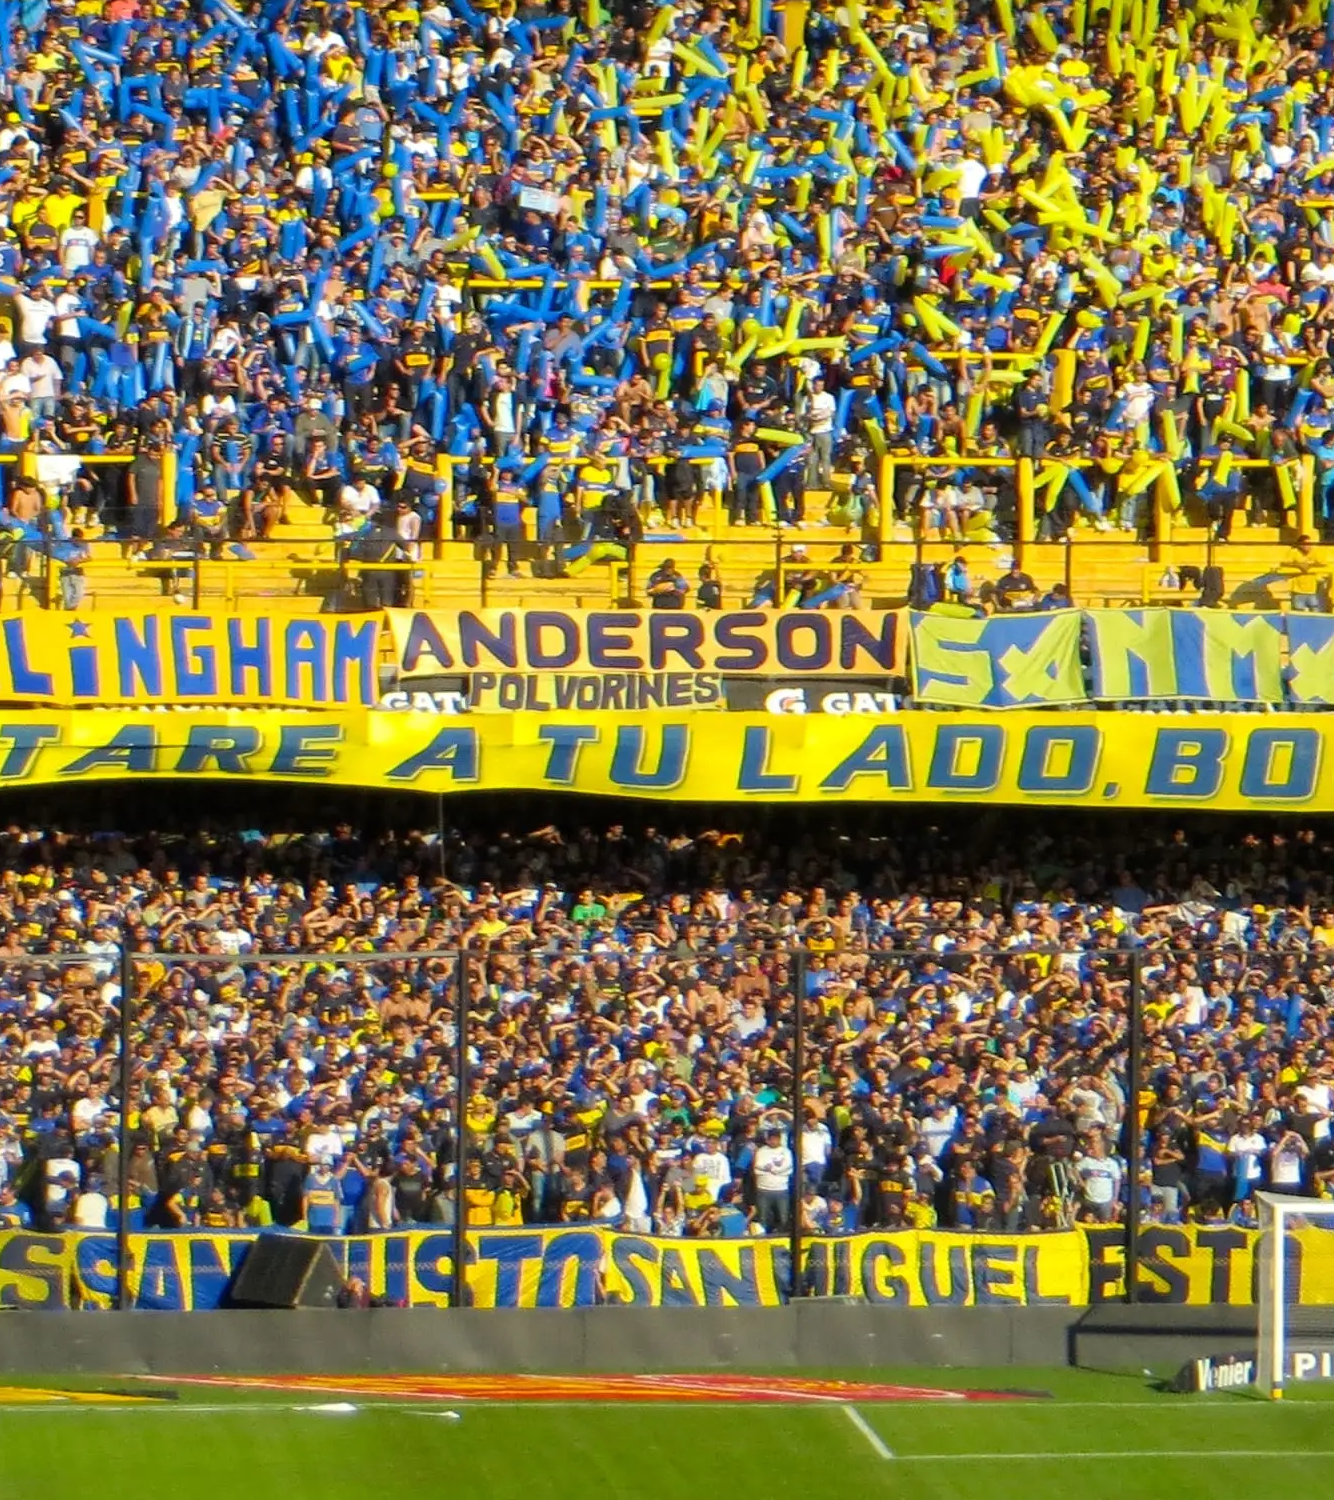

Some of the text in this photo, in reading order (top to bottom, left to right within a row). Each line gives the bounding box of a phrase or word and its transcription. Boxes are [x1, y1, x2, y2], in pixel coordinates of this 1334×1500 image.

[402, 610, 901, 671] ANDERSON
[471, 672, 721, 711] POLVORINES
[385, 726, 482, 784] A
[539, 722, 692, 790] TU
[735, 724, 1121, 800] LADO,
[327, 1232, 604, 1308] USTO
[1196, 1355, 1253, 1392] Venier
